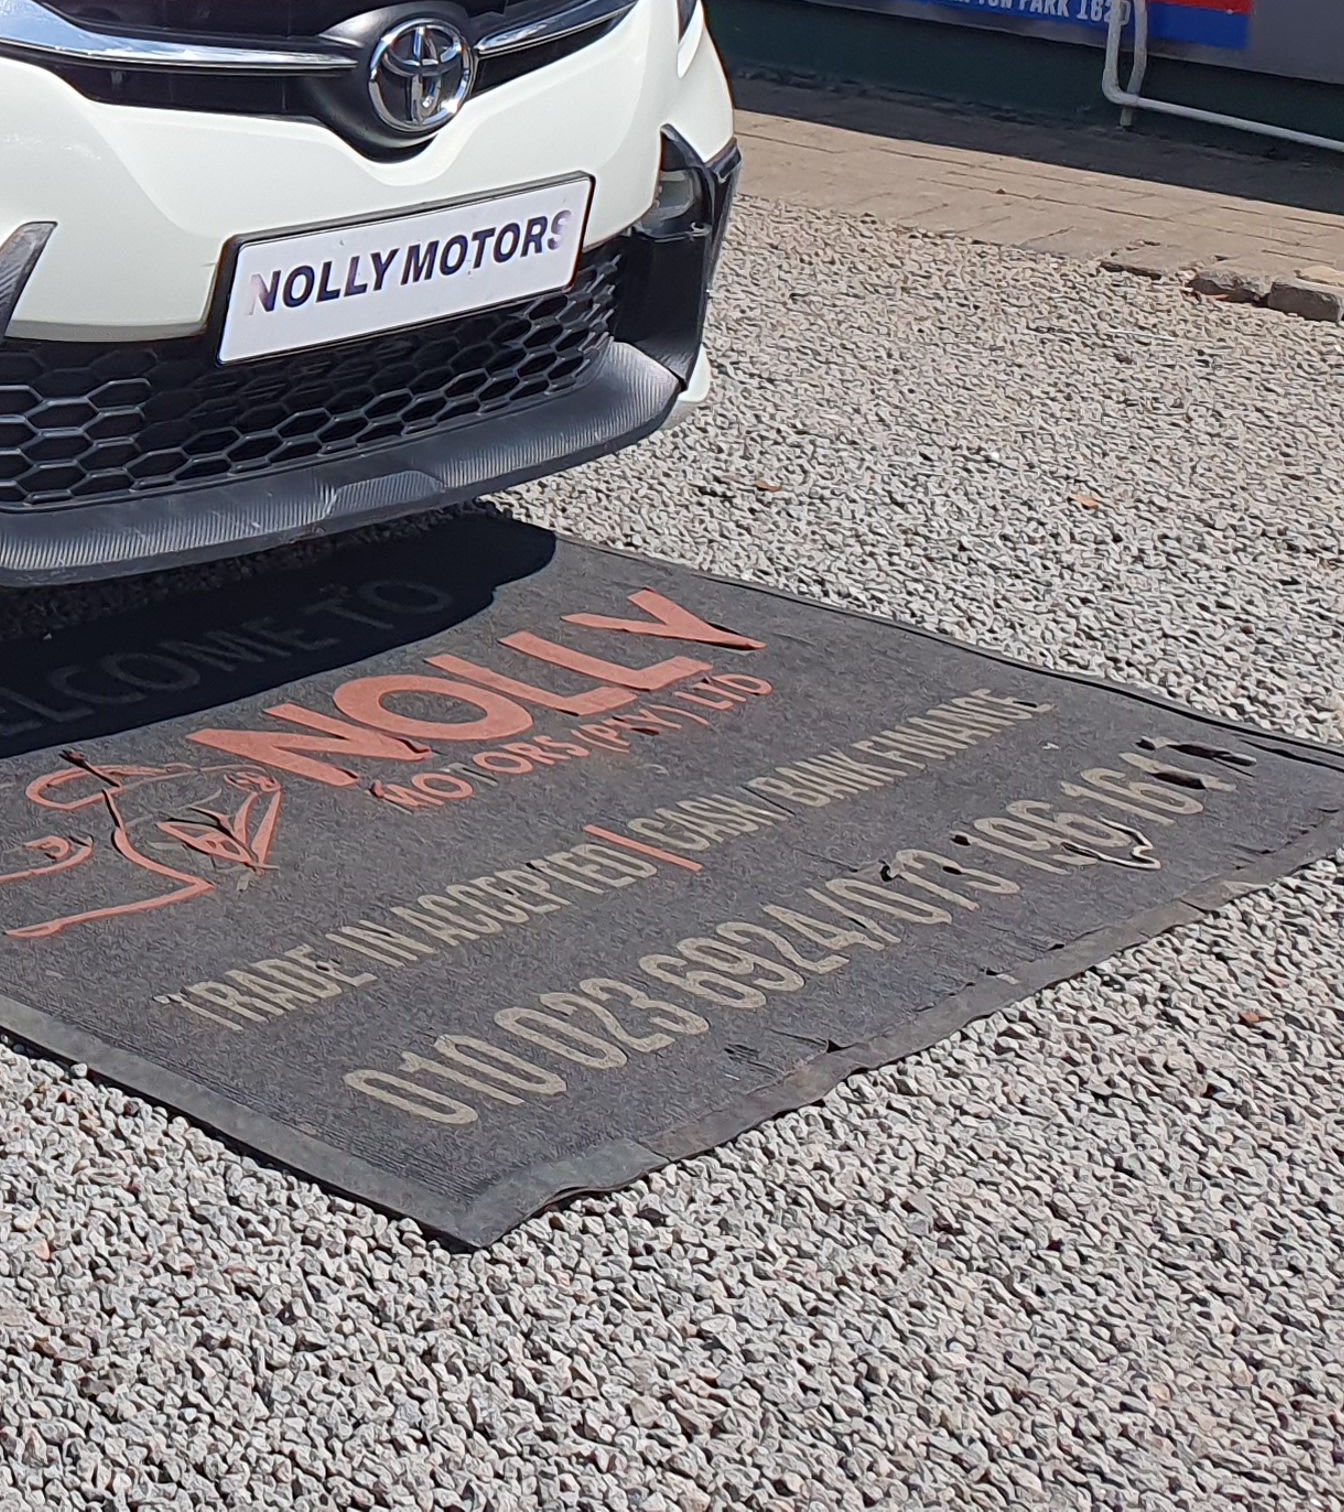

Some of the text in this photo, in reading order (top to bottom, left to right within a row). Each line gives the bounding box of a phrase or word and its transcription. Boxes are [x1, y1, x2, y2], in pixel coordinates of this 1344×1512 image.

[247, 209, 573, 316] NOLLY MOTORS
[306, 579, 456, 632] TO
[185, 587, 767, 787] NOLLY
[370, 735, 590, 810] MOTORS
[673, 674, 773, 711] LTD
[152, 943, 378, 1032] TRADE
[325, 919, 435, 968] IN
[391, 842, 659, 947] ACCEPTED
[852, 687, 1056, 772] FINANCE
[343, 1034, 567, 1125] 010
[494, 977, 710, 1069] 023
